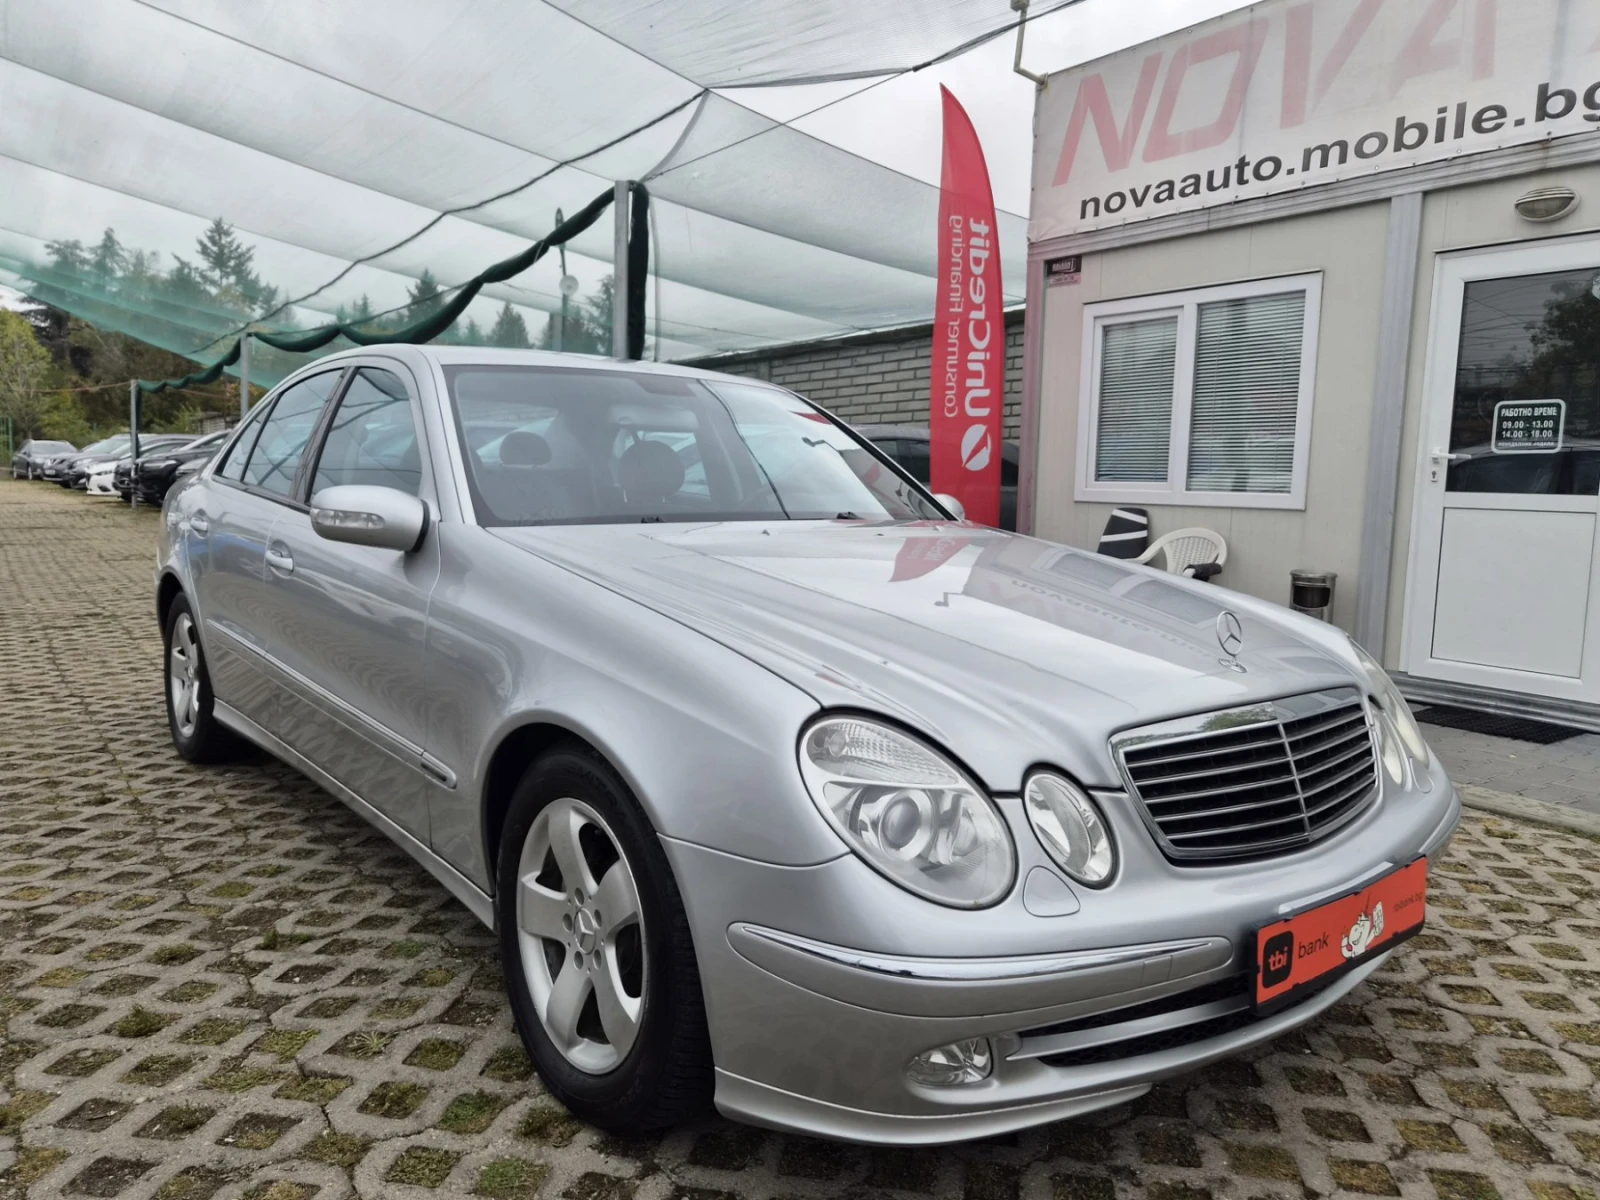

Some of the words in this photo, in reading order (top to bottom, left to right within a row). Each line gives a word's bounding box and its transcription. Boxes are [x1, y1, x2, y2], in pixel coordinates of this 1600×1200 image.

[1052, 0, 1497, 187] NOVA
[1501, 407, 1532, 417] РАБОТНО
[1533, 406, 1557, 416] ВРЕМЕ
[1502, 420, 1524, 429] 09.00
[1532, 420, 1554, 428] 13.00
[1502, 430, 1523, 438] 14.00
[1531, 429, 1553, 438] 18.00
[1268, 946, 1288, 971] tbi
[1298, 931, 1329, 960] bank
